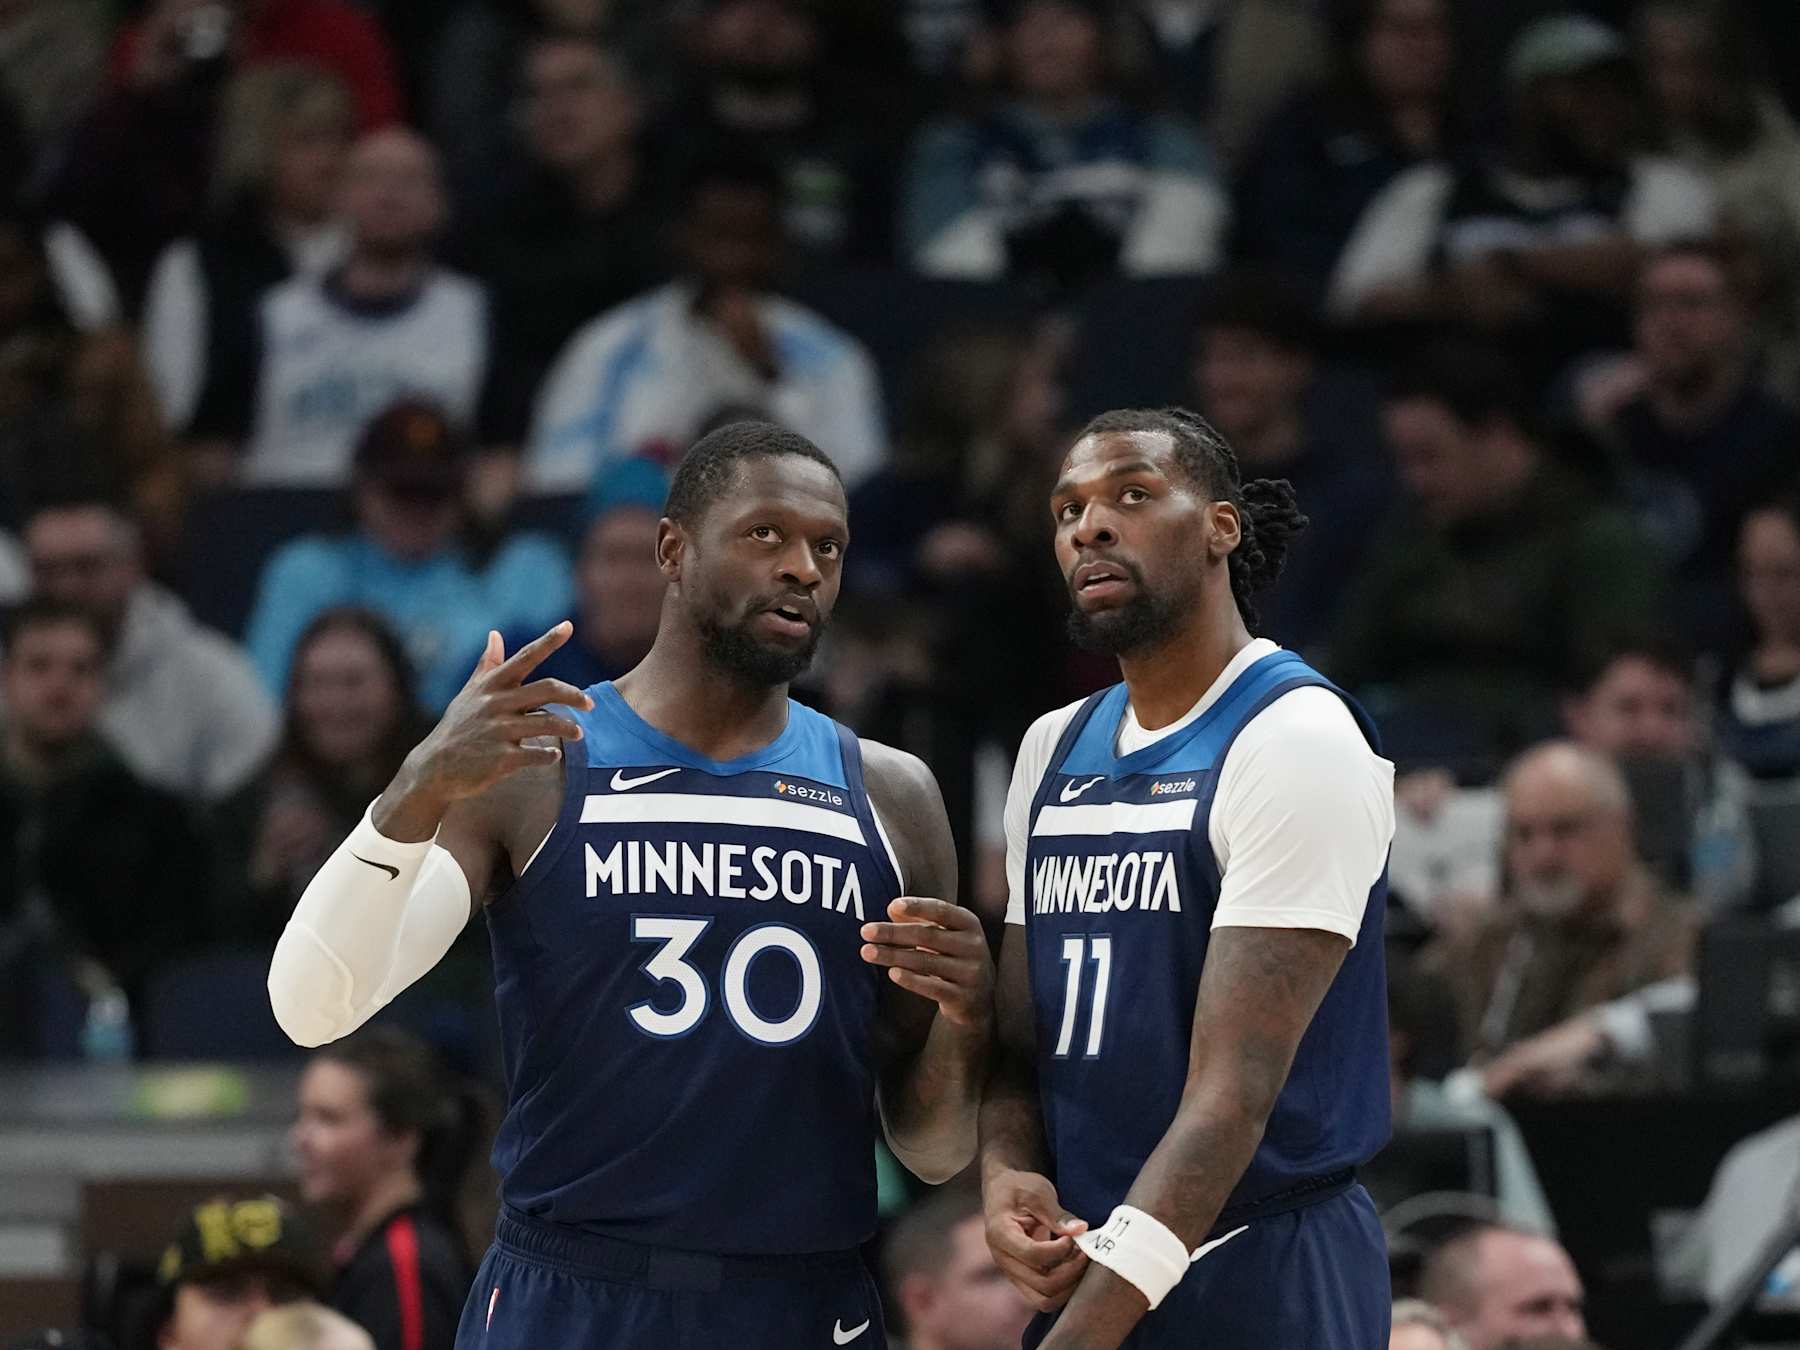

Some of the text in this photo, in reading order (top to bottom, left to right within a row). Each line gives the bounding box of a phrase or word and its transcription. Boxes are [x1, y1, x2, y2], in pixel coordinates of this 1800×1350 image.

[787, 784, 843, 806] sezzle
[1157, 777, 1196, 794] sezzle
[584, 840, 866, 922] MINNESOTA
[1032, 851, 1182, 916] MINNESOTA
[627, 915, 824, 1045] 30
[1054, 936, 1113, 1058] 11
